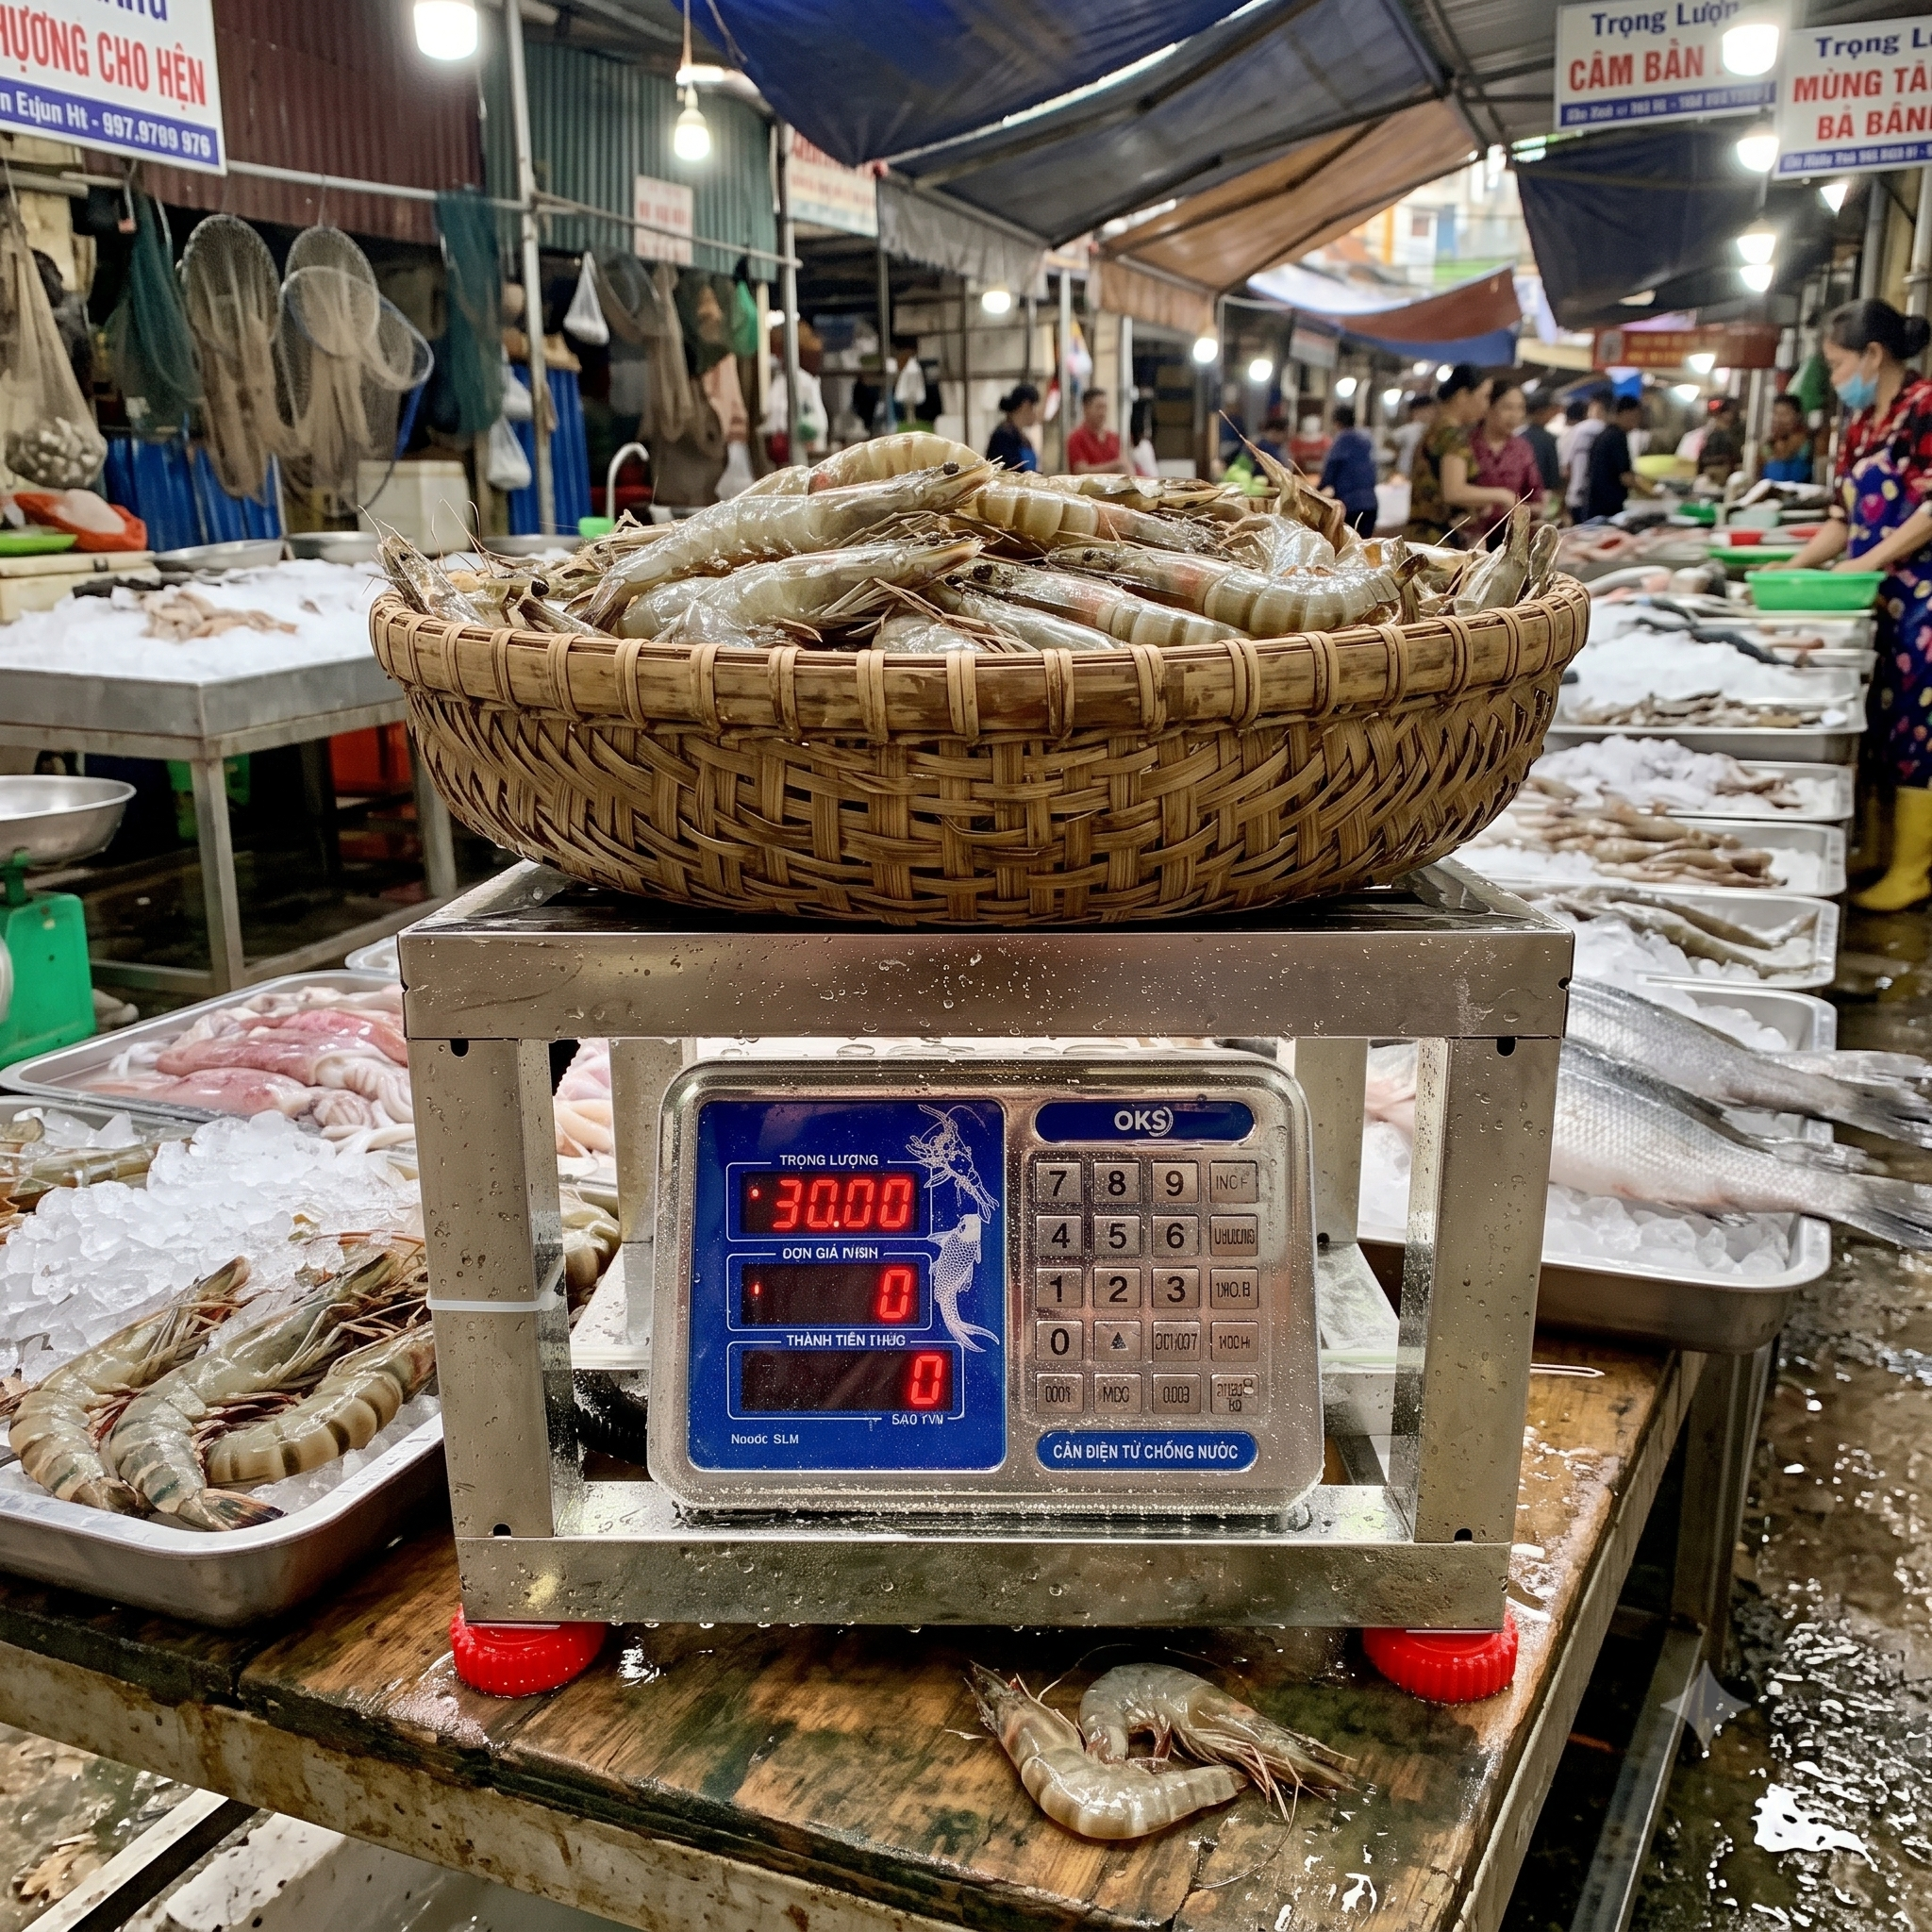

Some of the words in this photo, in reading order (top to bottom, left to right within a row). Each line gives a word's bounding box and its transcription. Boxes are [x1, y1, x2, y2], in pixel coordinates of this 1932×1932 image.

[1591, 11, 1667, 39] Trọng
[1676, 0, 1739, 26] Lượn
[1815, 34, 1901, 59] Trọng
[1913, 26, 1932, 48] L
[97, 31, 149, 92] CHO
[1893, 59, 1932, 93] TÂ
[1114, 1107, 1173, 1137] OKS
[779, 1155, 825, 1170] TRỌNG
[830, 1154, 879, 1169] LƯỢNG
[1049, 1170, 1067, 1196] 7
[1108, 1170, 1126, 1196] 8
[1165, 1170, 1184, 1196] 9
[772, 1179, 911, 1228] 30.00
[1051, 1223, 1071, 1249] 4
[1108, 1223, 1127, 1249] 5
[1166, 1223, 1185, 1249] 6
[816, 1243, 839, 1259] GIÁ
[879, 1269, 911, 1319] 0
[1049, 1275, 1063, 1303] 1
[1108, 1275, 1128, 1303] 2
[1166, 1275, 1186, 1303] 3
[787, 1331, 832, 1346] THÀNH
[1050, 1327, 1070, 1356] 0
[910, 1355, 943, 1405] 0
[774, 1434, 799, 1444] SLM
[1086, 1441, 1119, 1462] ĐIỆN
[1144, 1440, 1194, 1459] CHỐNG
